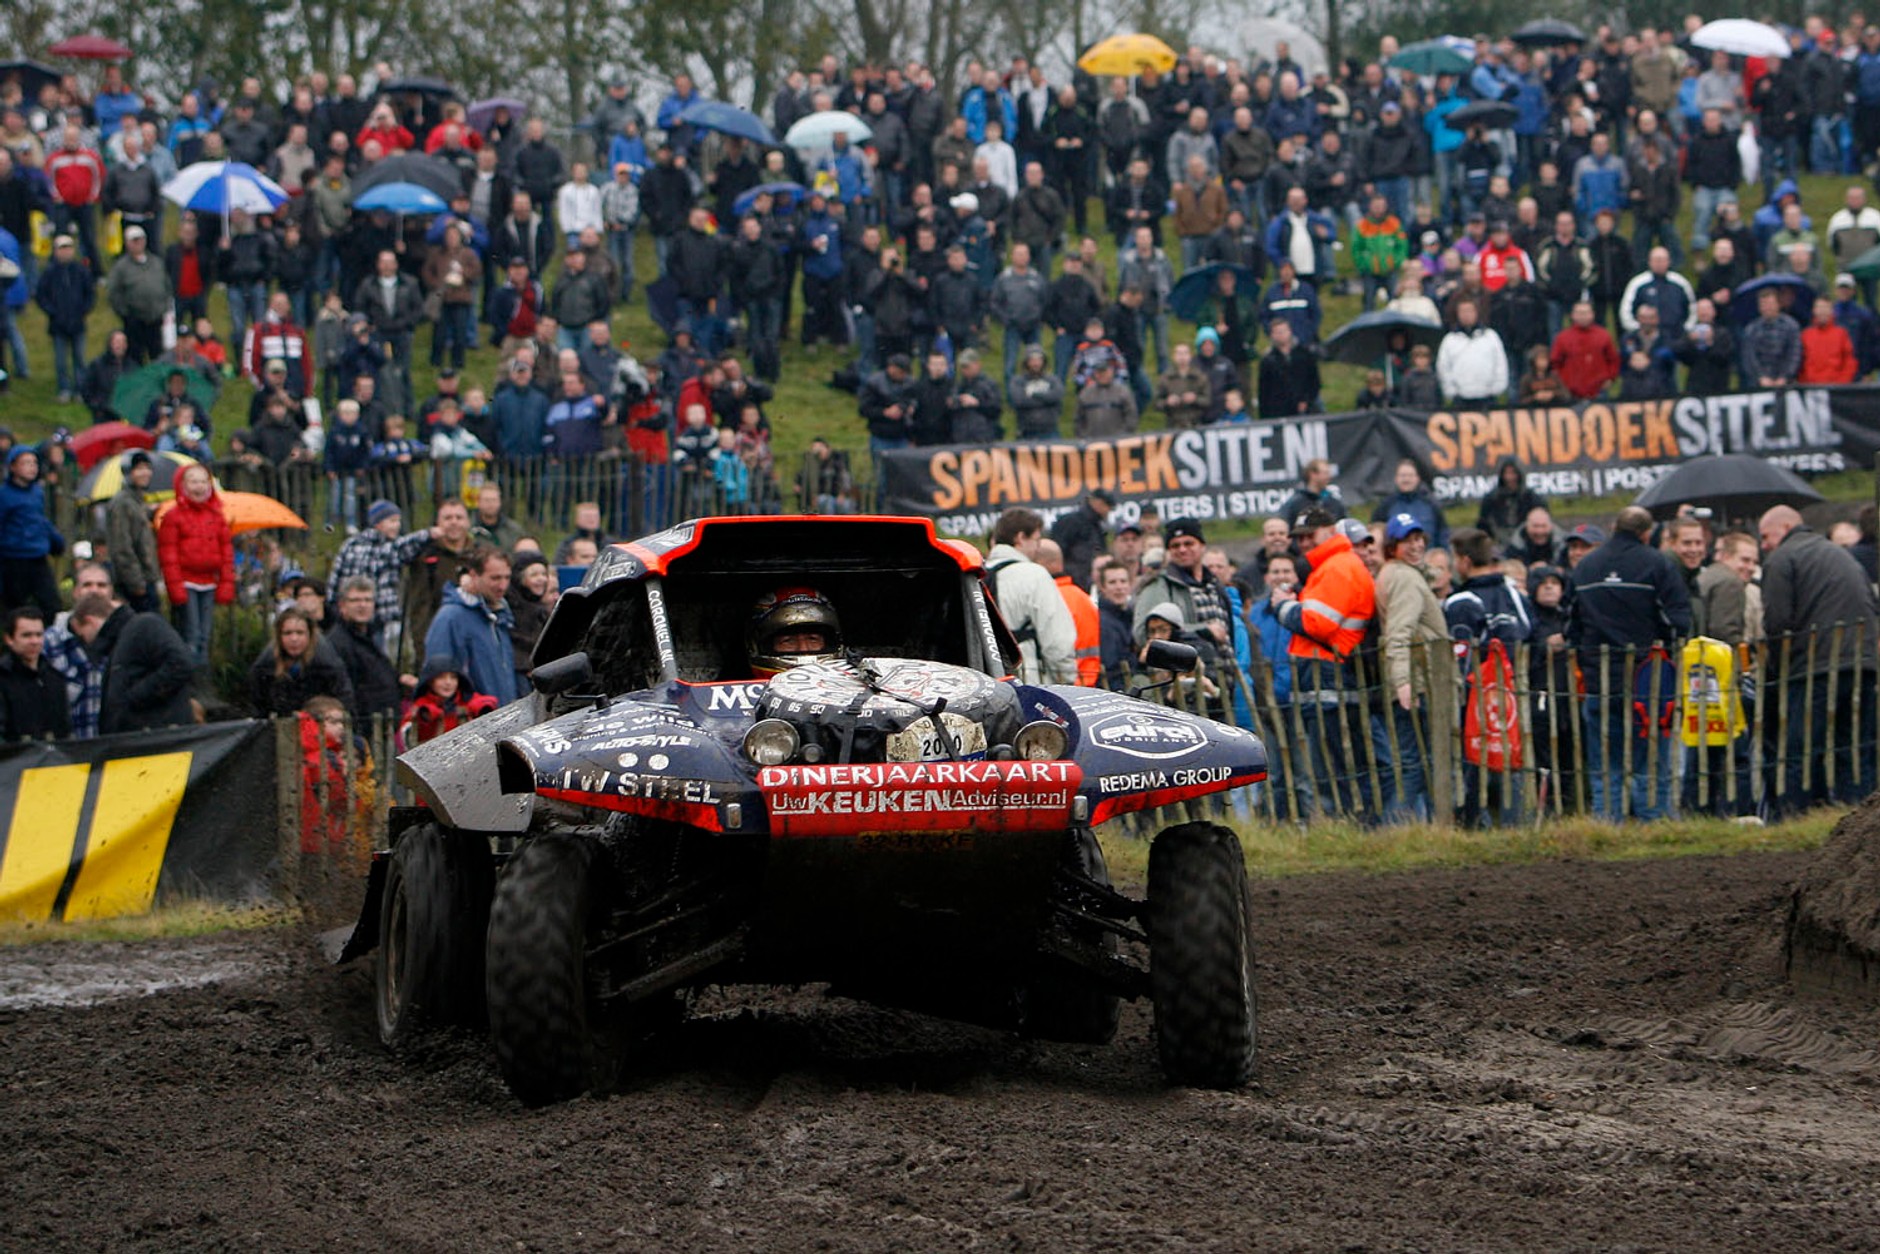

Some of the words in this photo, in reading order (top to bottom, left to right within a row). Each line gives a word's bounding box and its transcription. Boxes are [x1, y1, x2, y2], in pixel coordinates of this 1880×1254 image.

[1427, 390, 1843, 471] SPANDOEKSITE.NL
[1432, 469, 1592, 500] SPANEKEN
[1107, 495, 1214, 527] POTERS
[923, 735, 962, 757] 200
[1103, 735, 1200, 745] LUBRICANTS
[762, 762, 1077, 788] DINERJAARKAART
[1100, 770, 1170, 793] REDEMA
[1172, 765, 1233, 786] GROUP
